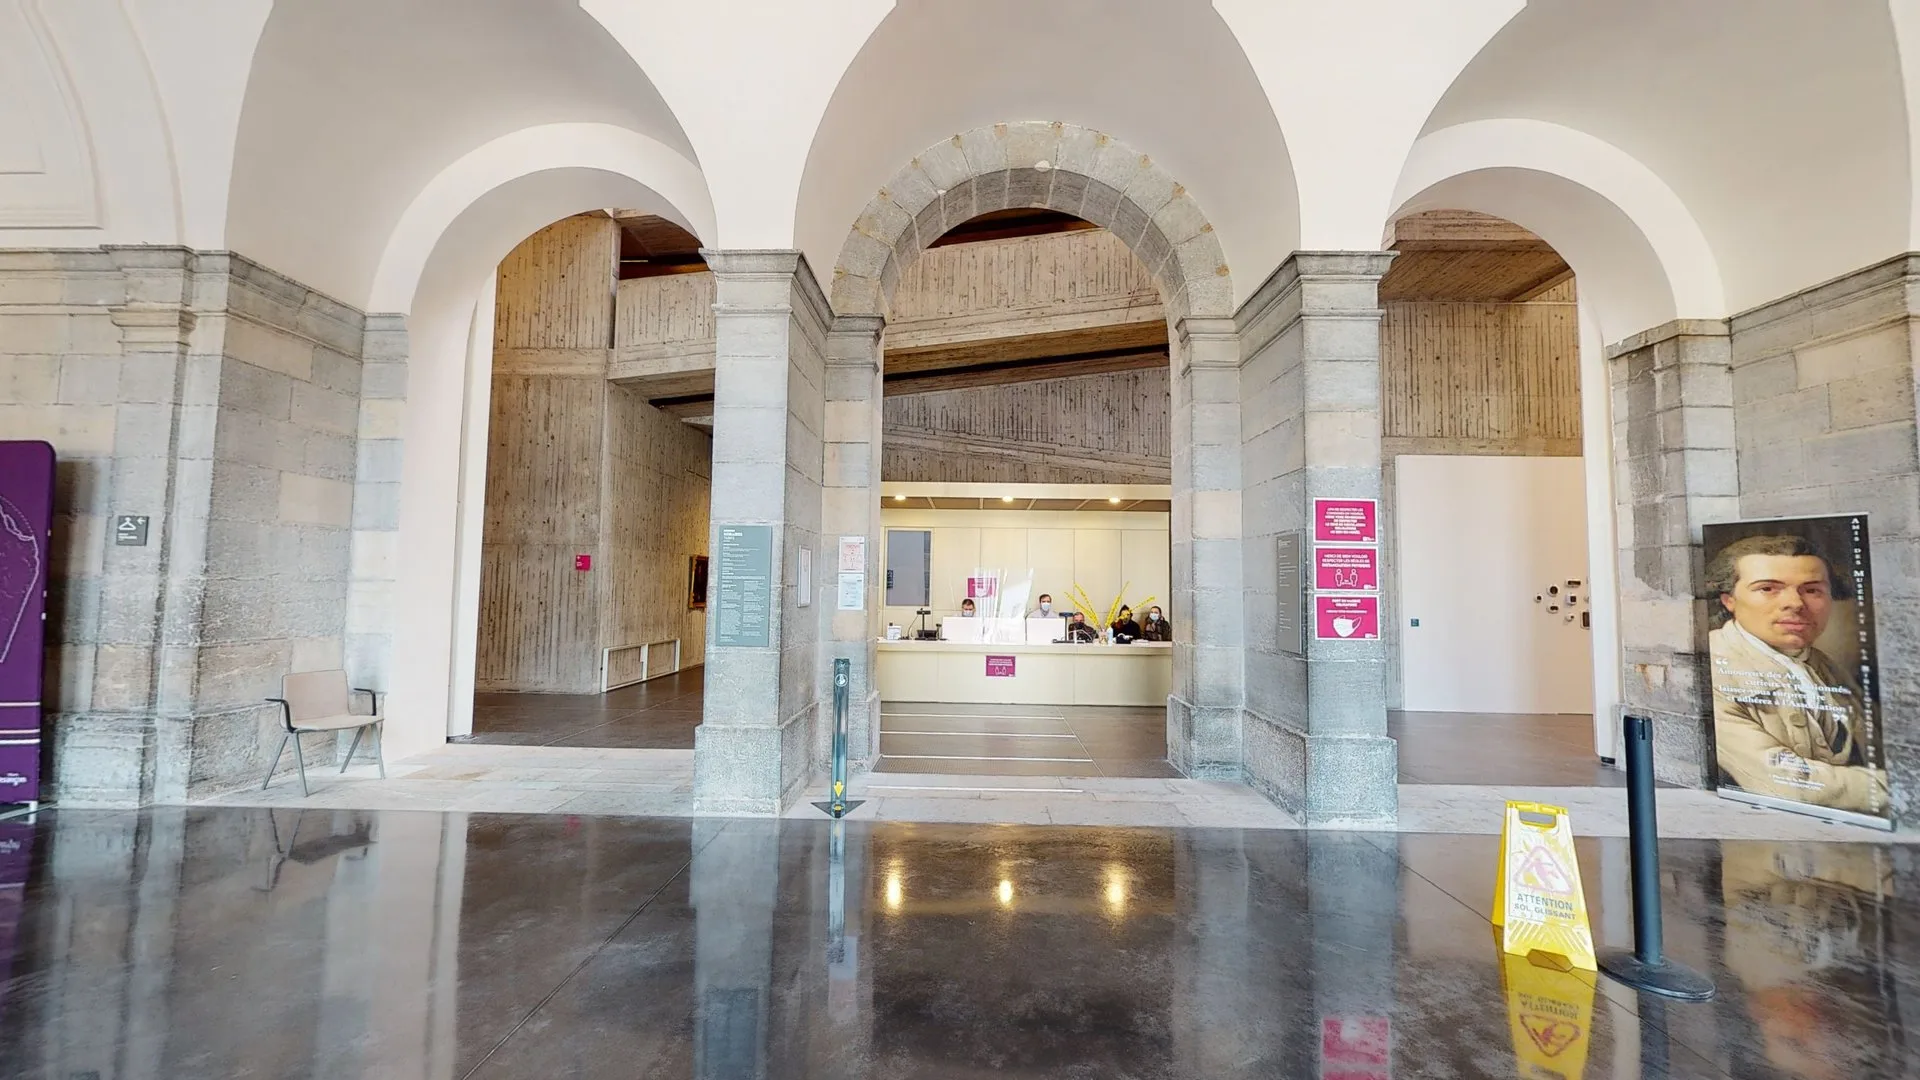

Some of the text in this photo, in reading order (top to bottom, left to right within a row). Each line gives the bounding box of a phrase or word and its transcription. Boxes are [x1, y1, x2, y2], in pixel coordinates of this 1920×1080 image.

[1517, 893, 1574, 912] ATTENTION
[1514, 903, 1577, 921] SOL GLISSANT
